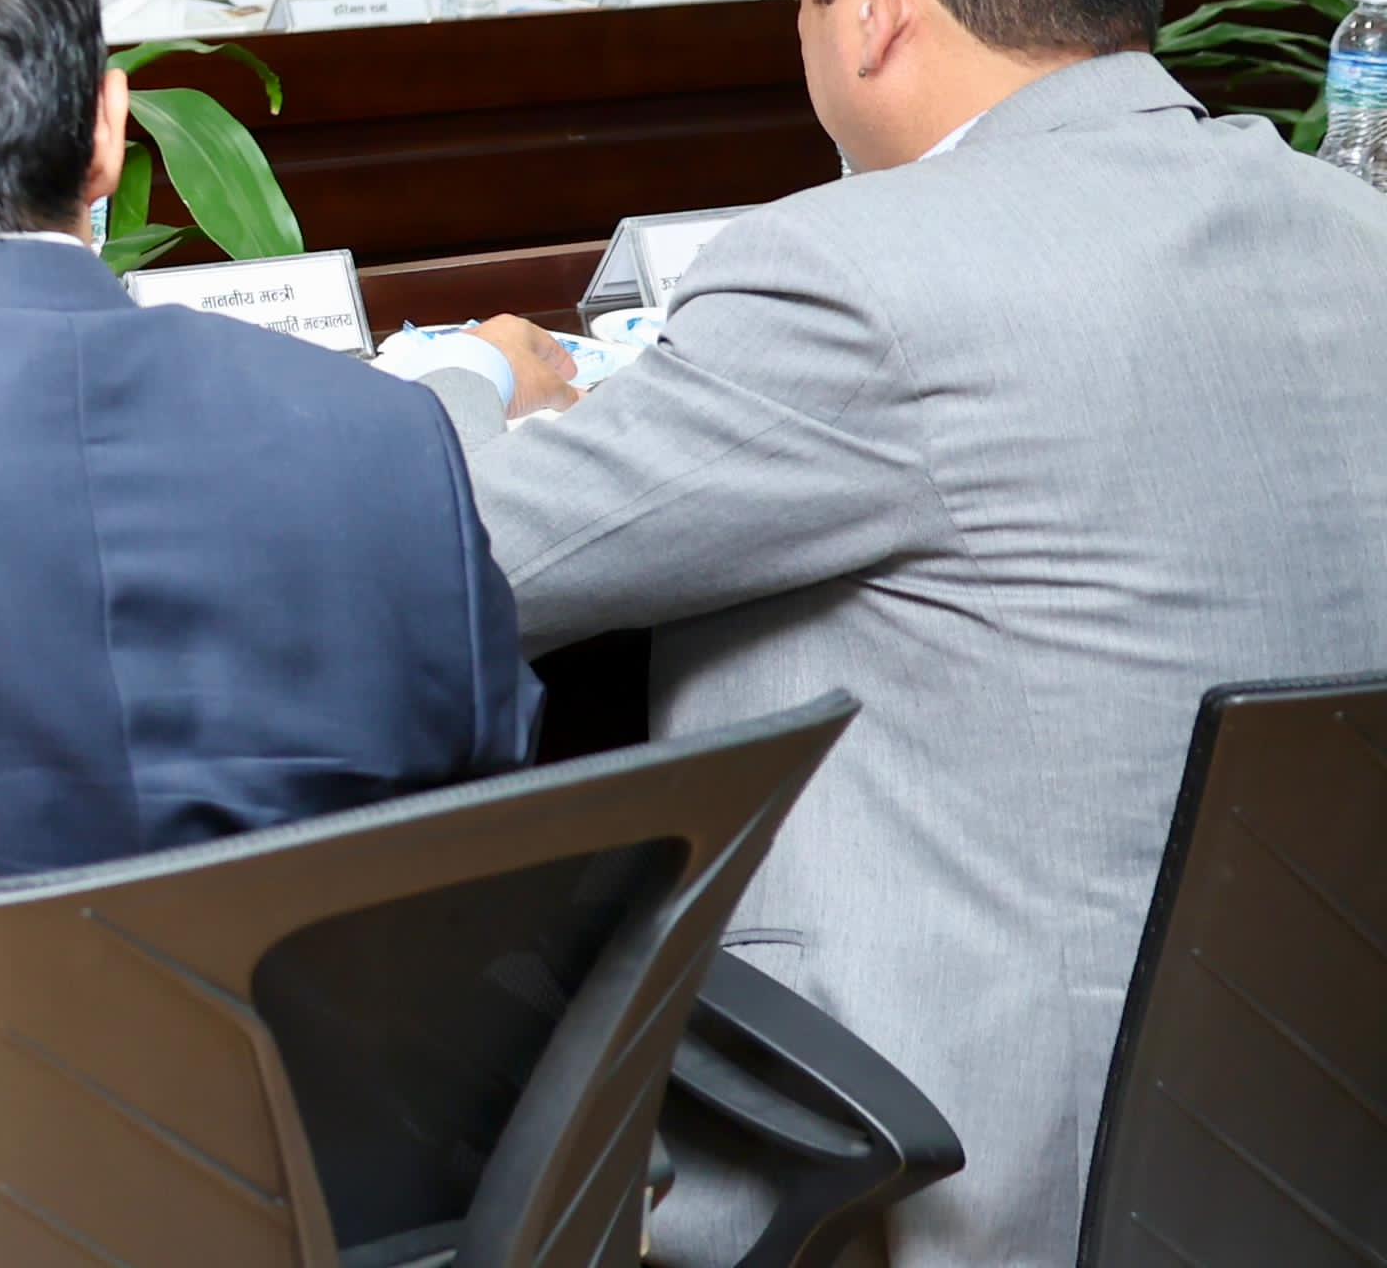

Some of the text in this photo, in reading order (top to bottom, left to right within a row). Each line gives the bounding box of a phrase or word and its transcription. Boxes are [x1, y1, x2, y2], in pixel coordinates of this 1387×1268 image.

[201, 283, 296, 310] माननीय मन्त्री
[301, 313, 354, 332] मन्त्रालय
